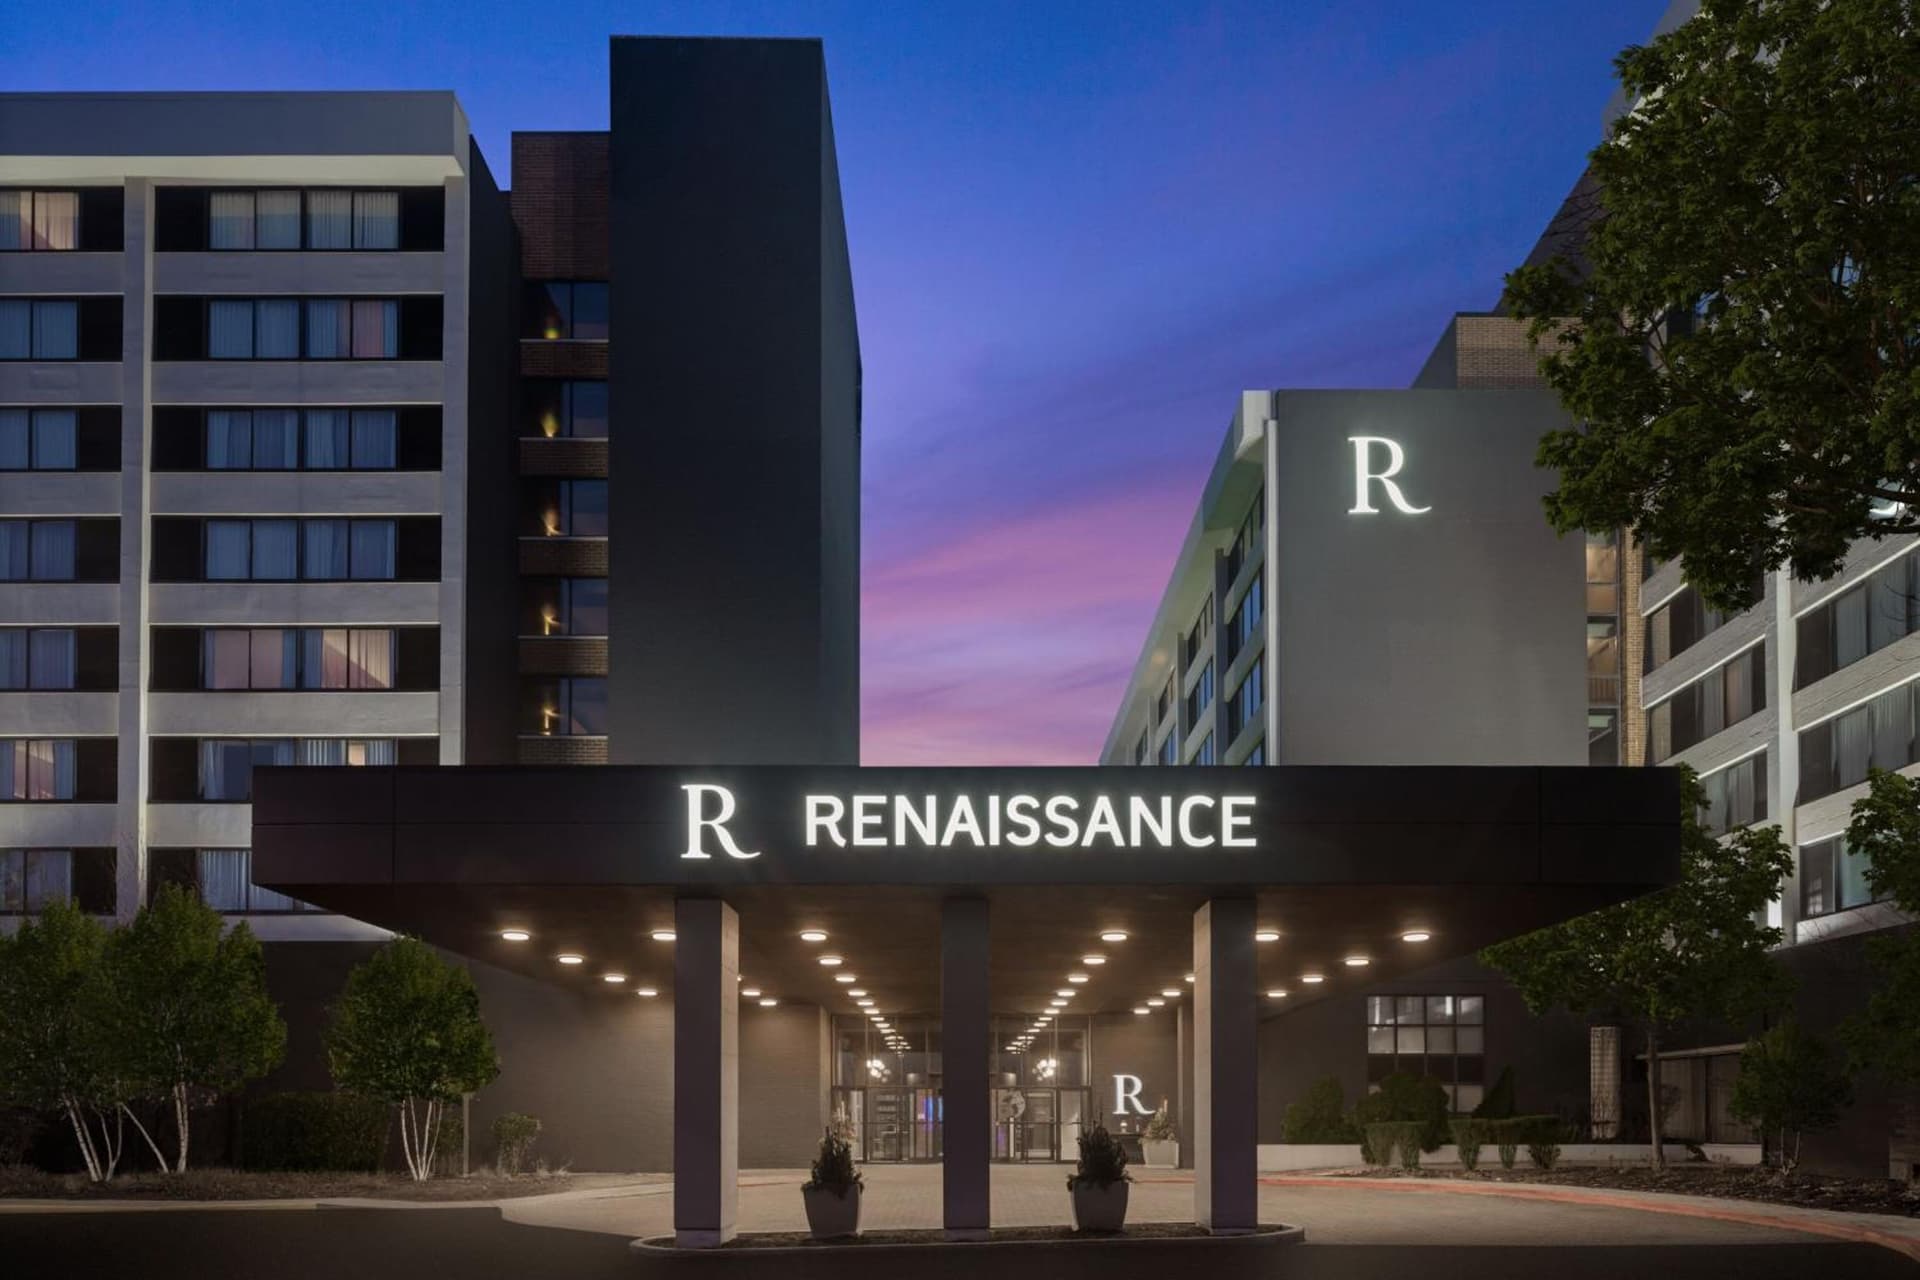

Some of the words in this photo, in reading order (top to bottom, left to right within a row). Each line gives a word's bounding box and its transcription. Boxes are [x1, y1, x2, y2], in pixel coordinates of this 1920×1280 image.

[1347, 435, 1432, 515] R
[680, 783, 761, 860] R
[804, 793, 1258, 849] RENAISSANCE
[1112, 1073, 1156, 1115] R
